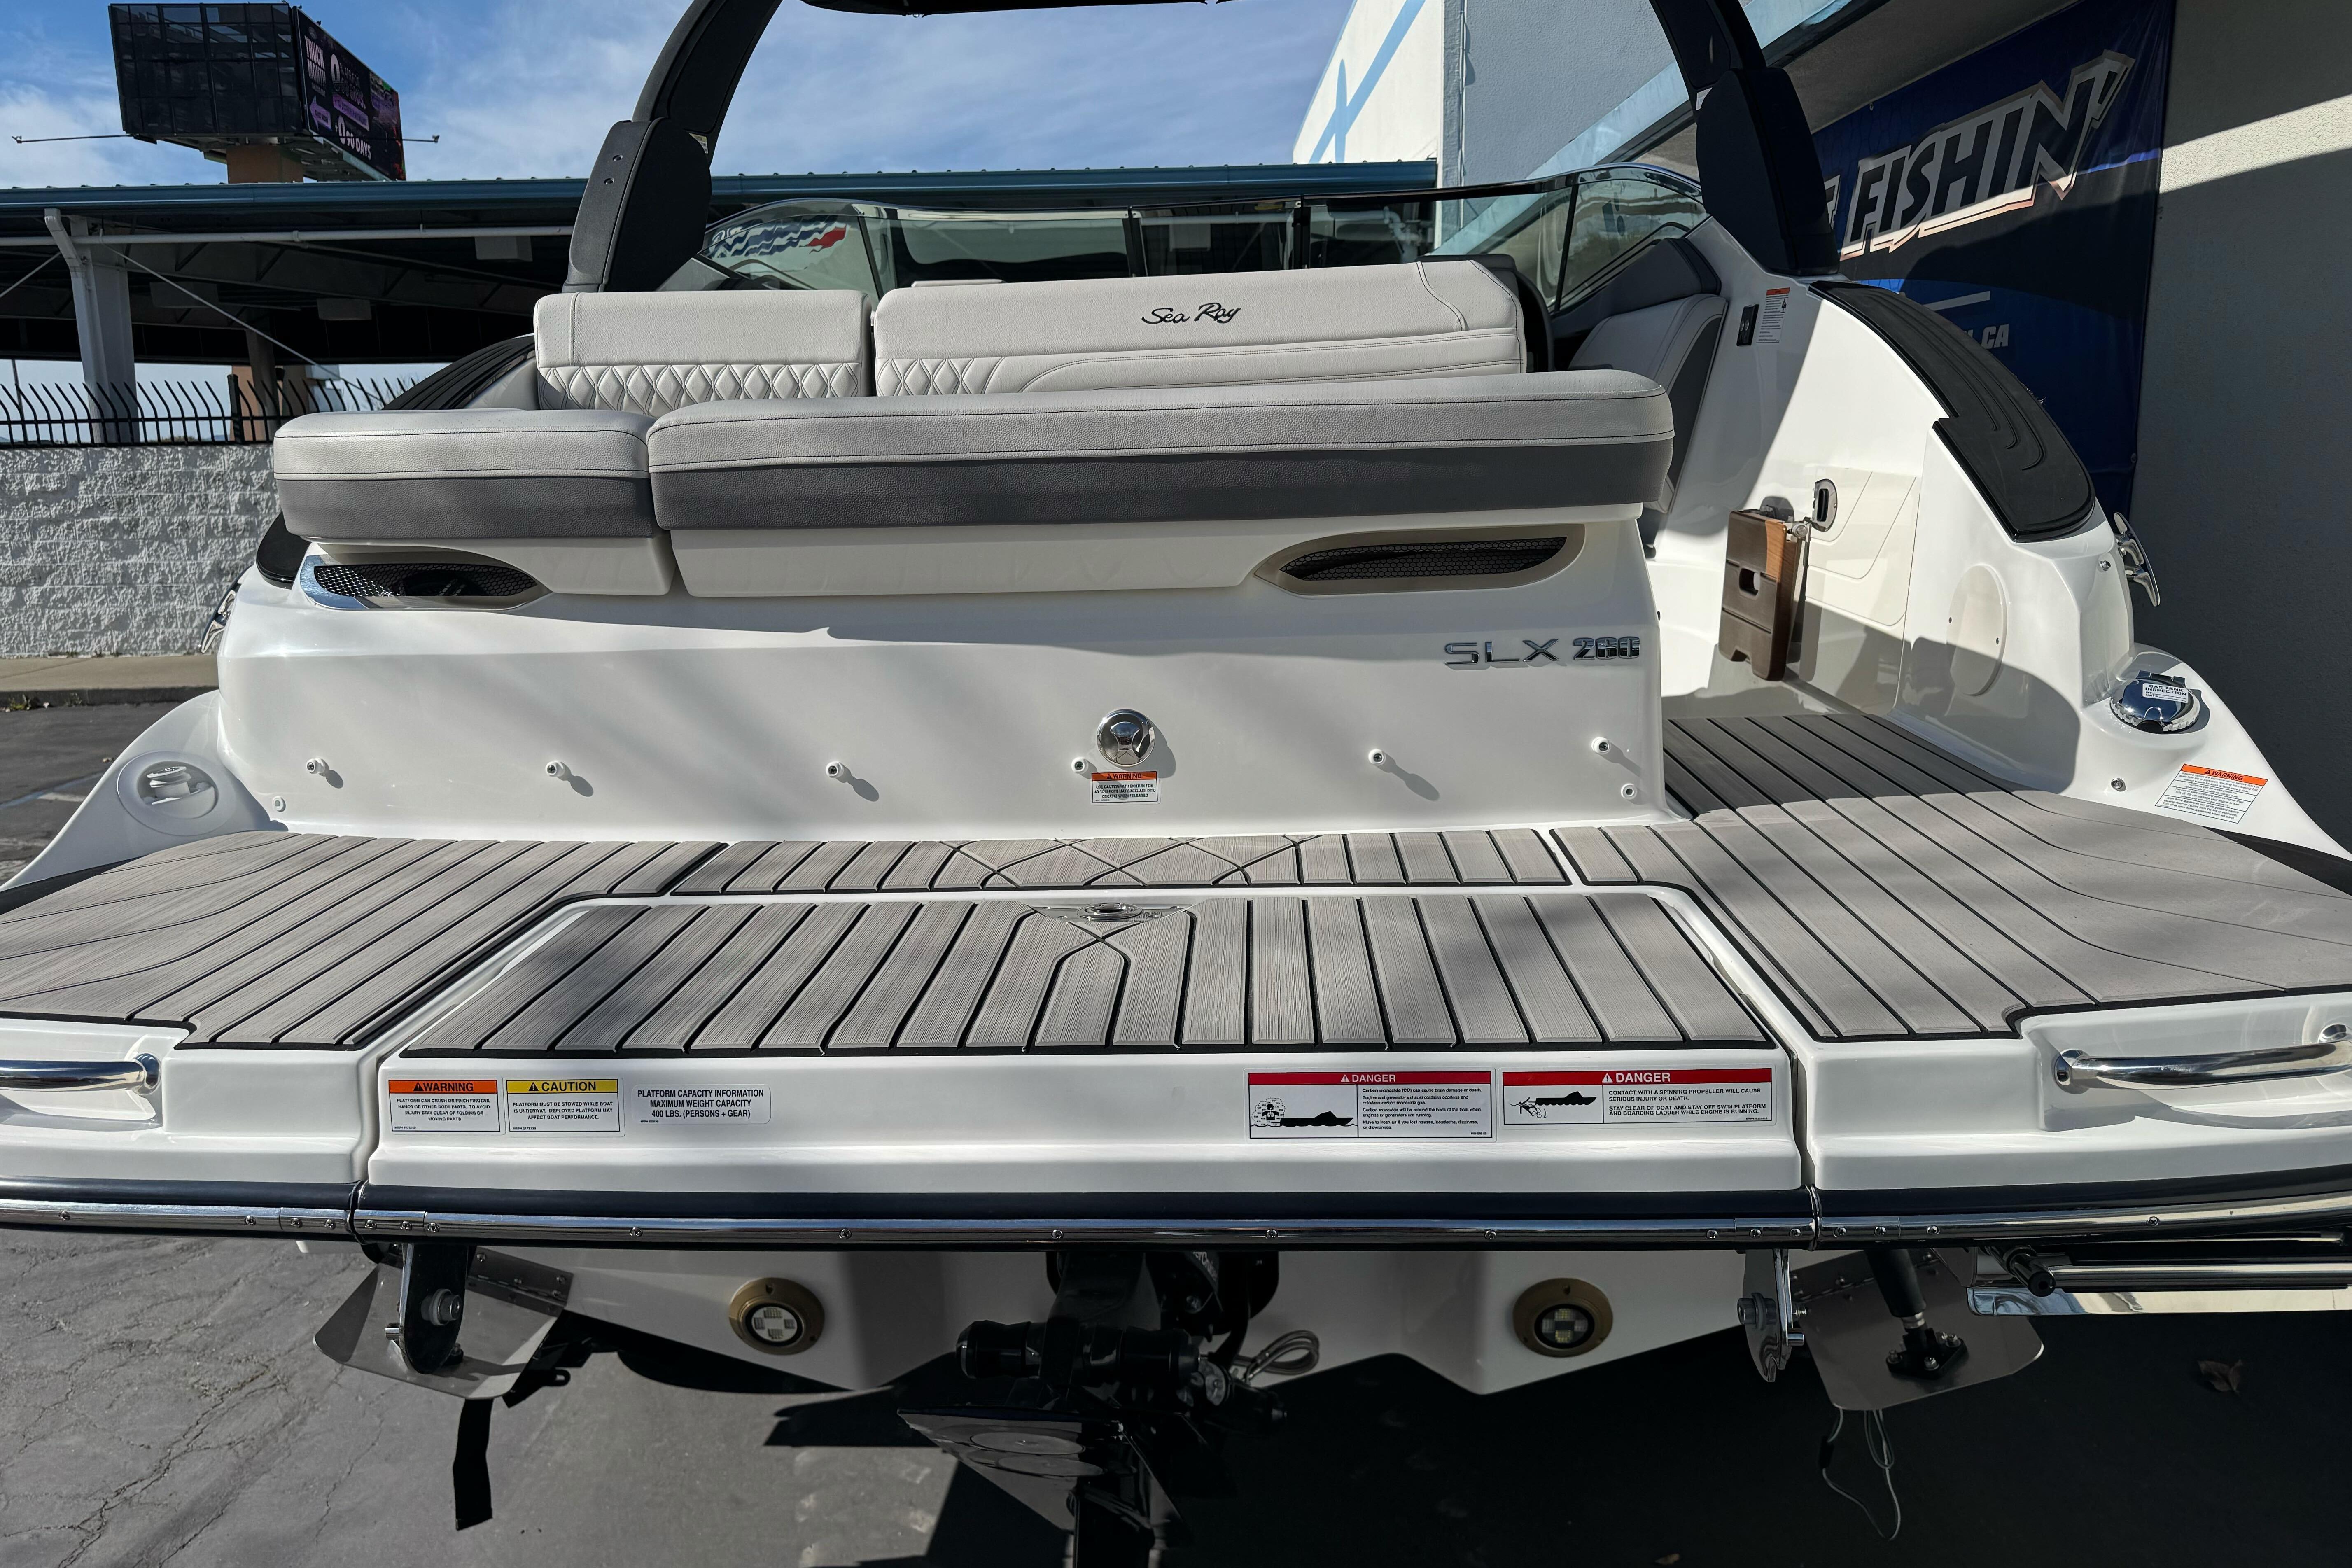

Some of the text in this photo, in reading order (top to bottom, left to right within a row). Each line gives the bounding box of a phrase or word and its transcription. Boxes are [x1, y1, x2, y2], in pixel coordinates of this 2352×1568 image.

[356, 138, 371, 160] DAYS
[1141, 302, 1241, 324] Sea Ray
[1444, 639, 1559, 665] SLX
[2145, 687, 2186, 696] INSPECTION
[2212, 770, 2244, 781] WARNING
[1616, 1072, 1671, 1083] DANGER
[423, 1082, 474, 1092] WARNING
[541, 1081, 596, 1091] CAUTION
[683, 1110, 719, 1118] (PERSONS
[728, 1109, 750, 1118] GEAR)
